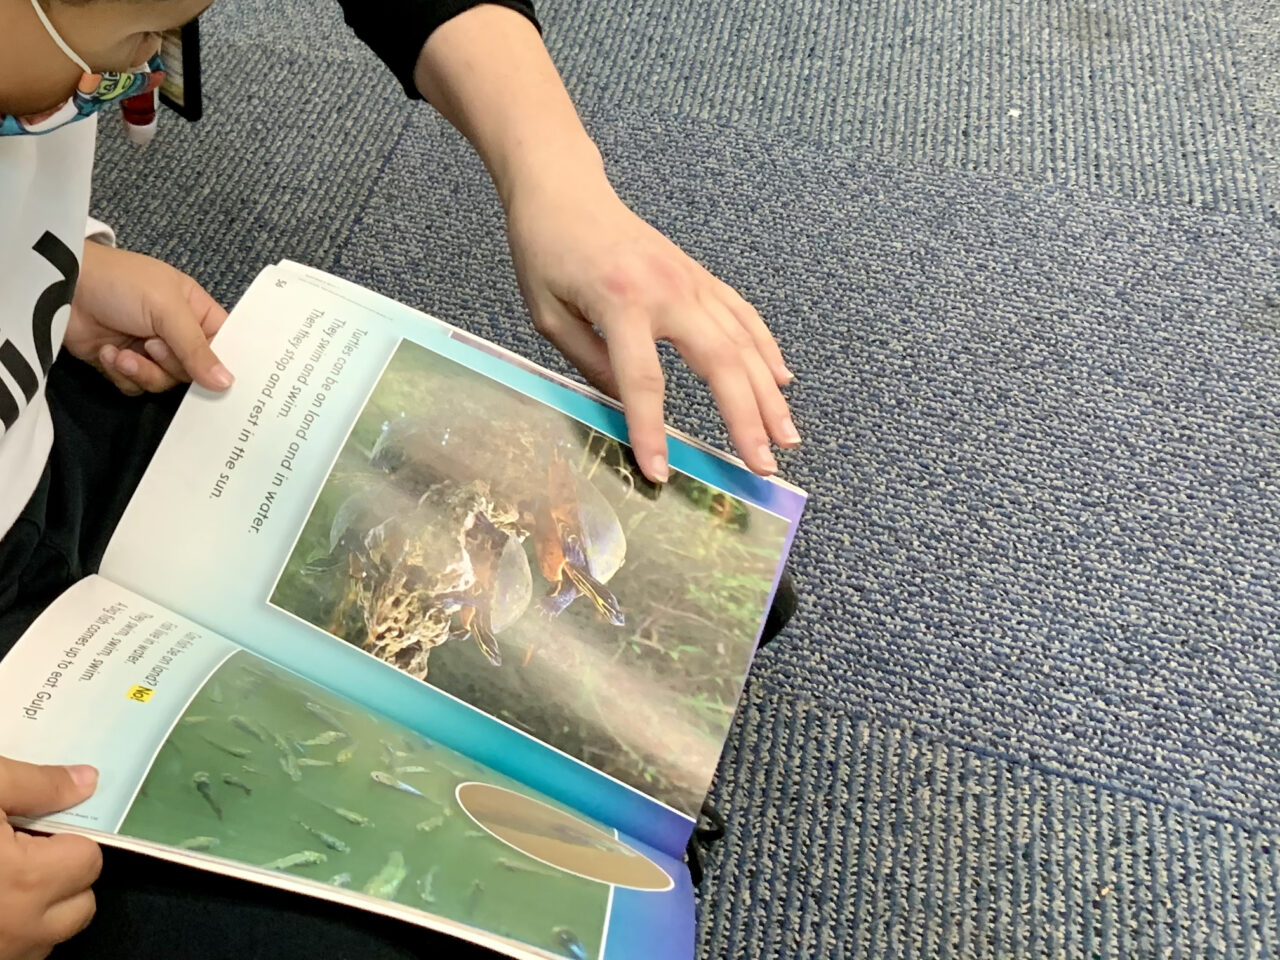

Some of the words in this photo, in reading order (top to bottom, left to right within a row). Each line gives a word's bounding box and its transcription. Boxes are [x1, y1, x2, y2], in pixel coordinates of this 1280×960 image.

[301, 309, 325, 330] Then
[323, 318, 346, 338] They
[288, 329, 310, 349] they
[342, 329, 368, 356] Turtles
[275, 349, 295, 371] stop
[310, 338, 330, 363] swim
[297, 363, 314, 386] and
[330, 357, 346, 376] can
[261, 373, 280, 399] and
[321, 377, 338, 391] be
[275, 385, 301, 419] swim.
[312, 393, 326, 407] on
[248, 399, 266, 426] rest
[238, 429, 254, 442] in
[296, 410, 320, 440] land
[225, 446, 245, 470] the
[281, 442, 299, 471] and
[209, 473, 229, 500] sun.
[272, 473, 288, 486] in
[248, 492, 277, 533] water.
[96, 614, 114, 625] fish
[114, 621, 138, 636] swim,
[75, 624, 100, 646] comes
[149, 629, 168, 642] live
[174, 638, 194, 649] fish
[96, 637, 121, 656] swim,
[124, 644, 149, 664] water.
[42, 671, 62, 688] eat.
[78, 658, 103, 682] swim.
[143, 665, 168, 686] land?
[131, 686, 152, 702] No!
[23, 691, 51, 720] Gulp!
